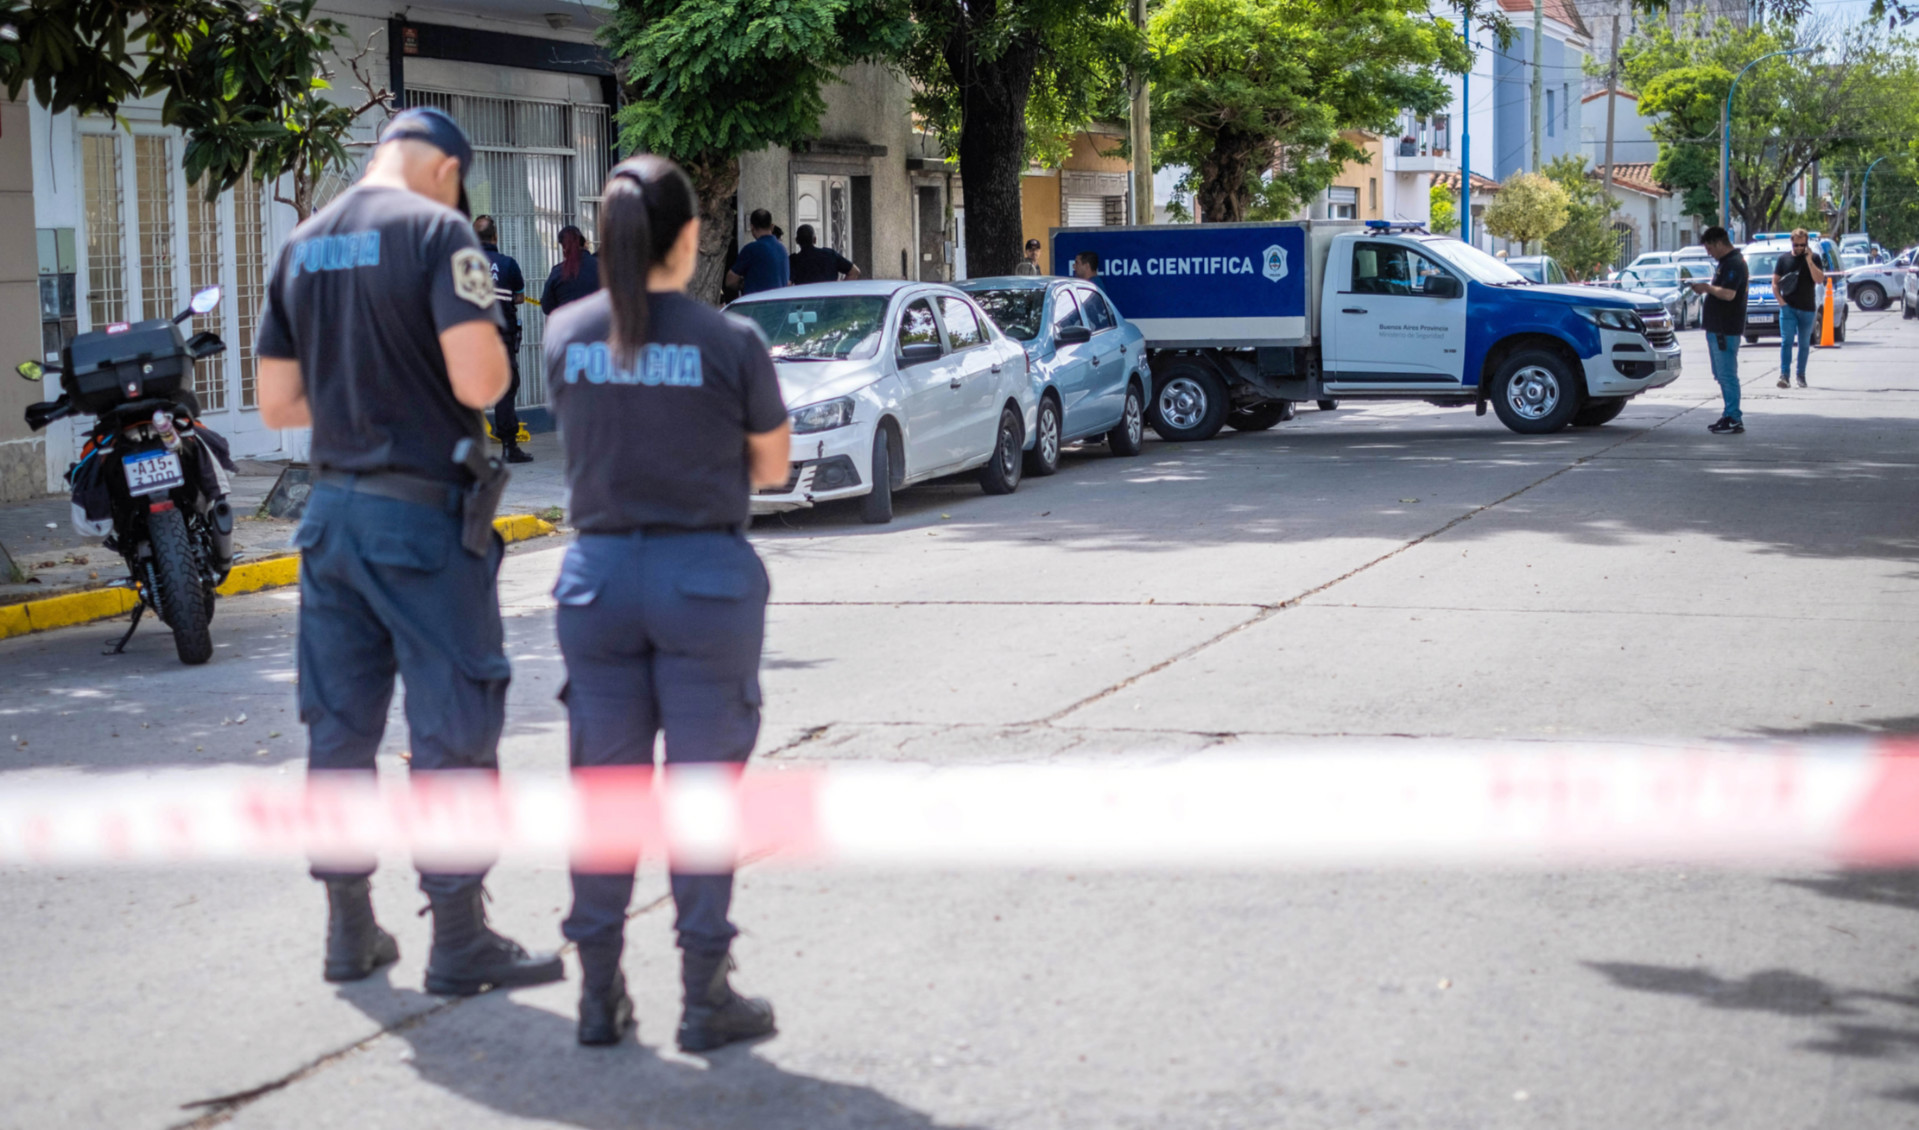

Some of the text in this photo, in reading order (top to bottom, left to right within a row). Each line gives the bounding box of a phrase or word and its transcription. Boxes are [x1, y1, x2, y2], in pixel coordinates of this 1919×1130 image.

[1068, 256, 1254, 276] PICIA CIENTIFICA
[138, 458, 167, 475] A15
